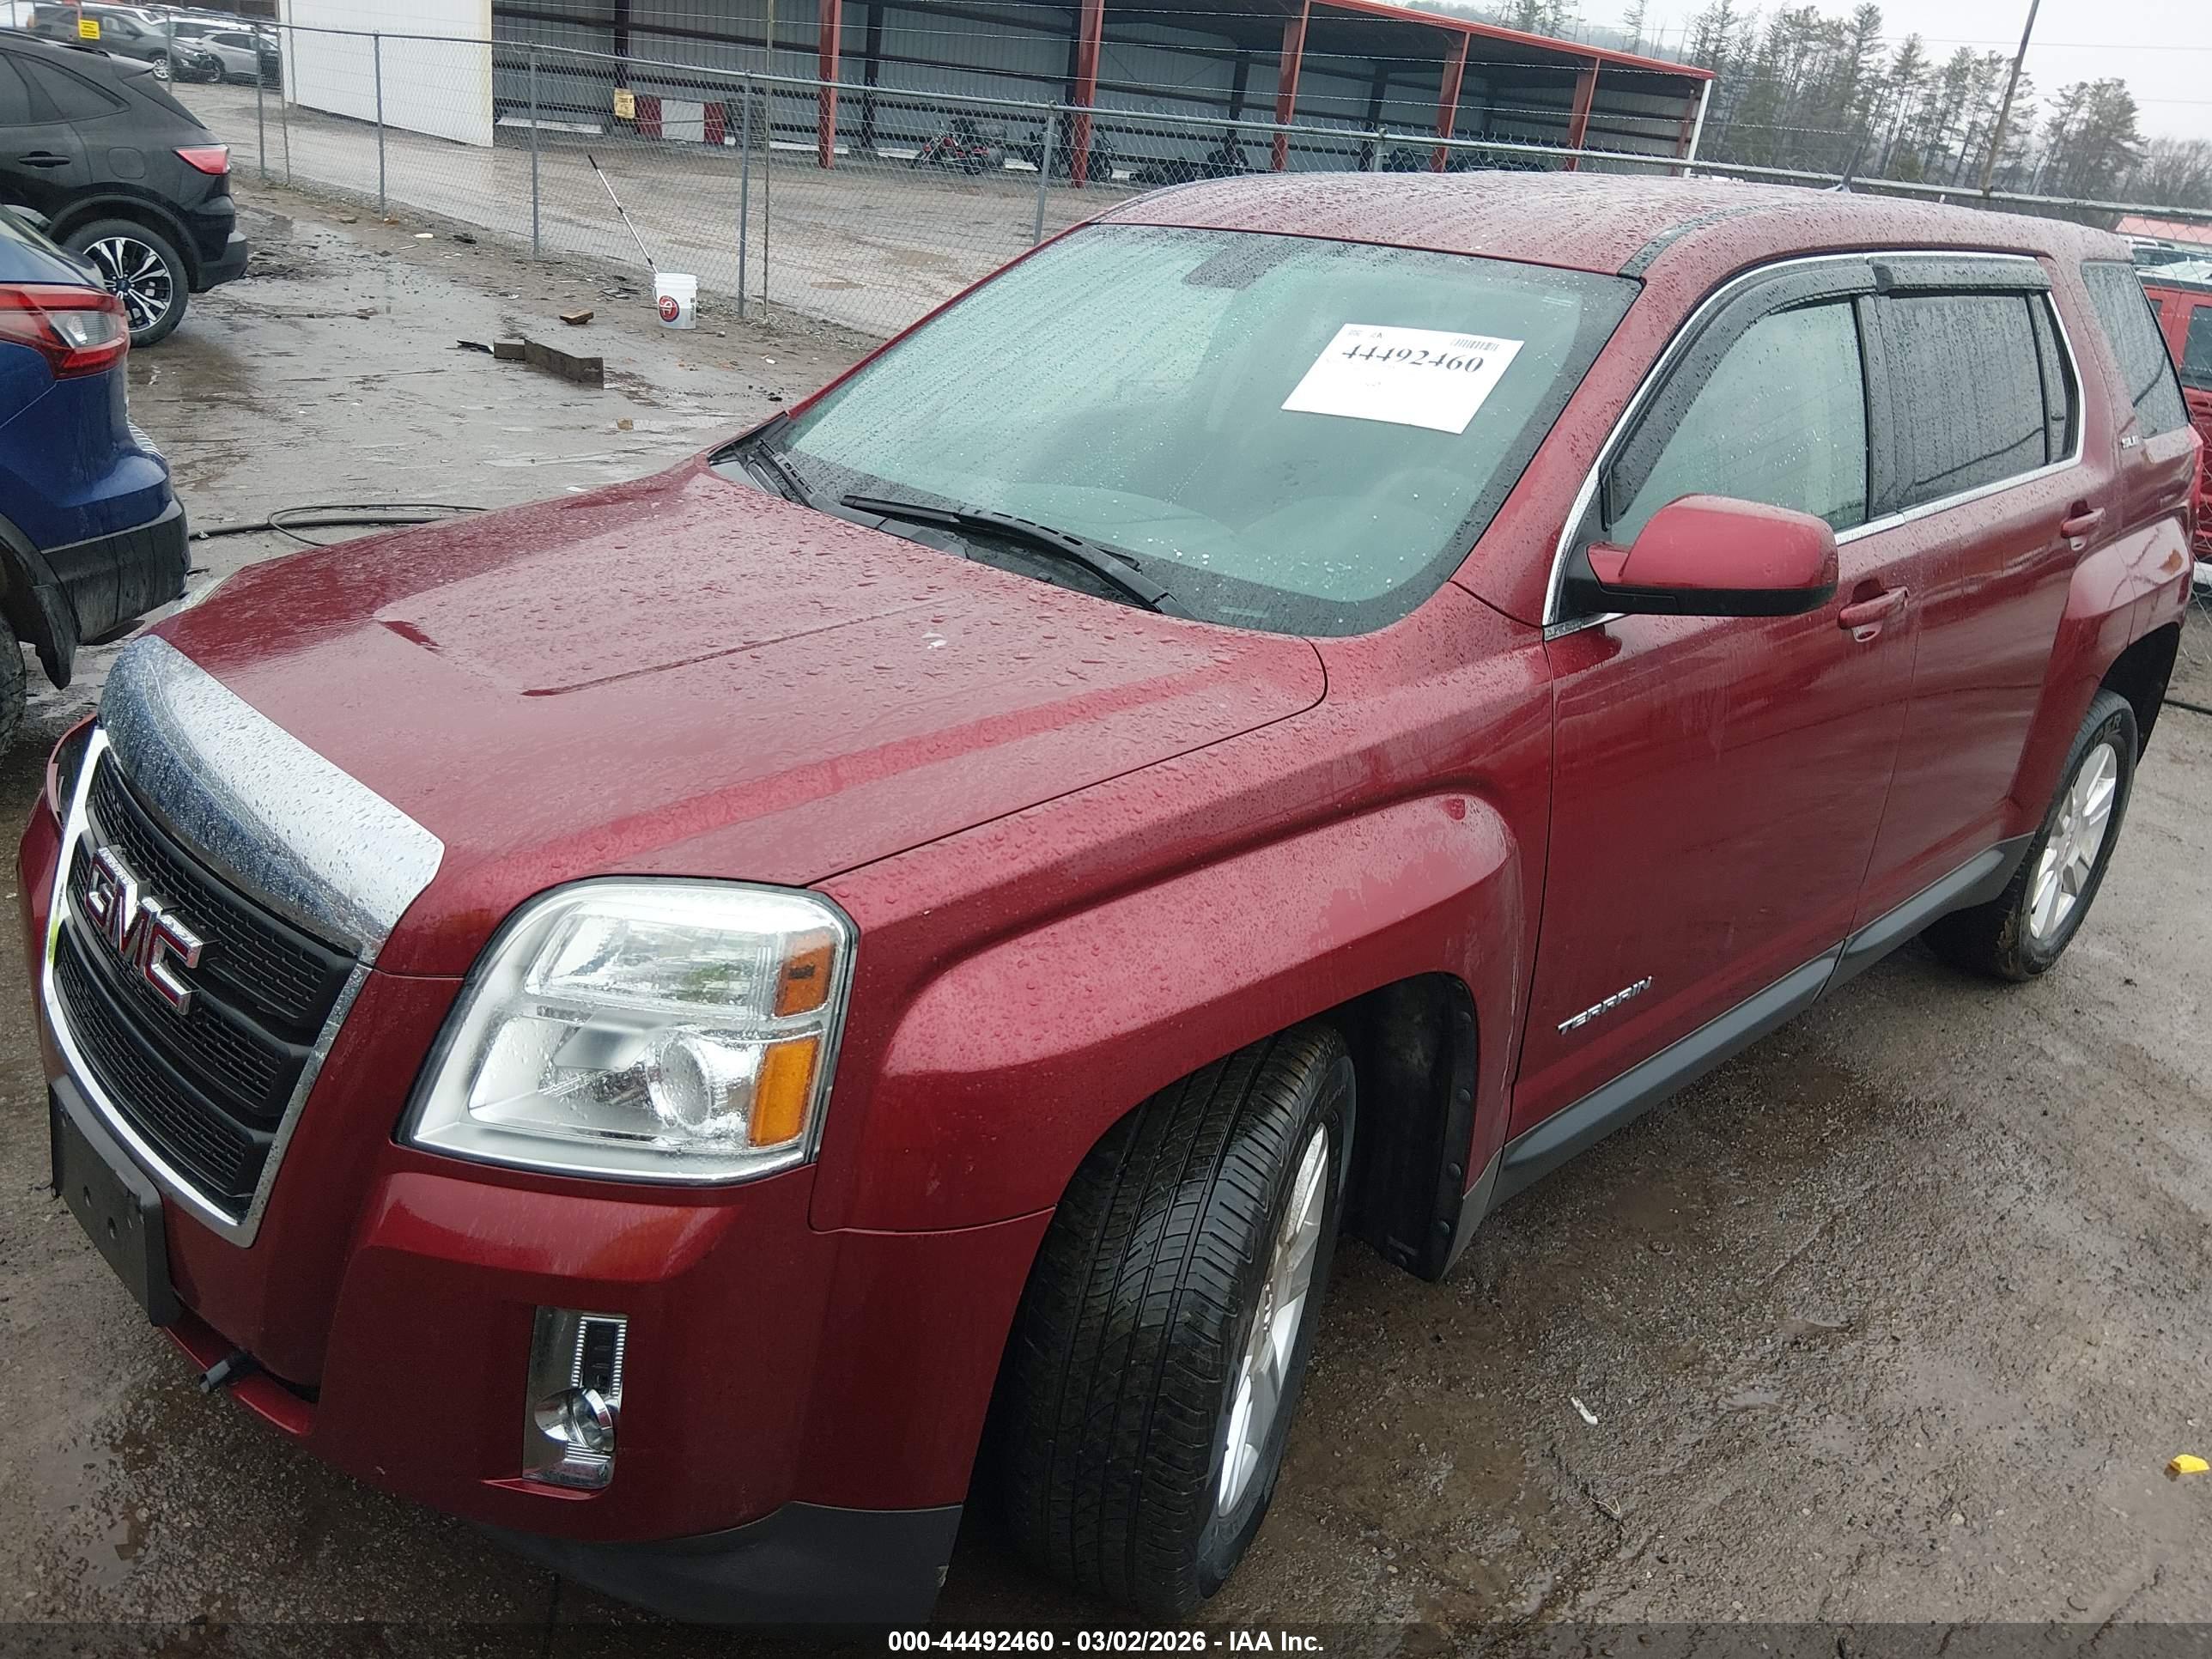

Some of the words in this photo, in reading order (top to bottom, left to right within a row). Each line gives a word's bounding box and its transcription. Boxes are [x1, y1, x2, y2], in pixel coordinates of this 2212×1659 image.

[1342, 344, 1484, 373] 44492460
[84, 847, 203, 1016] GMC
[1557, 975, 1653, 1036] TERRAIN
